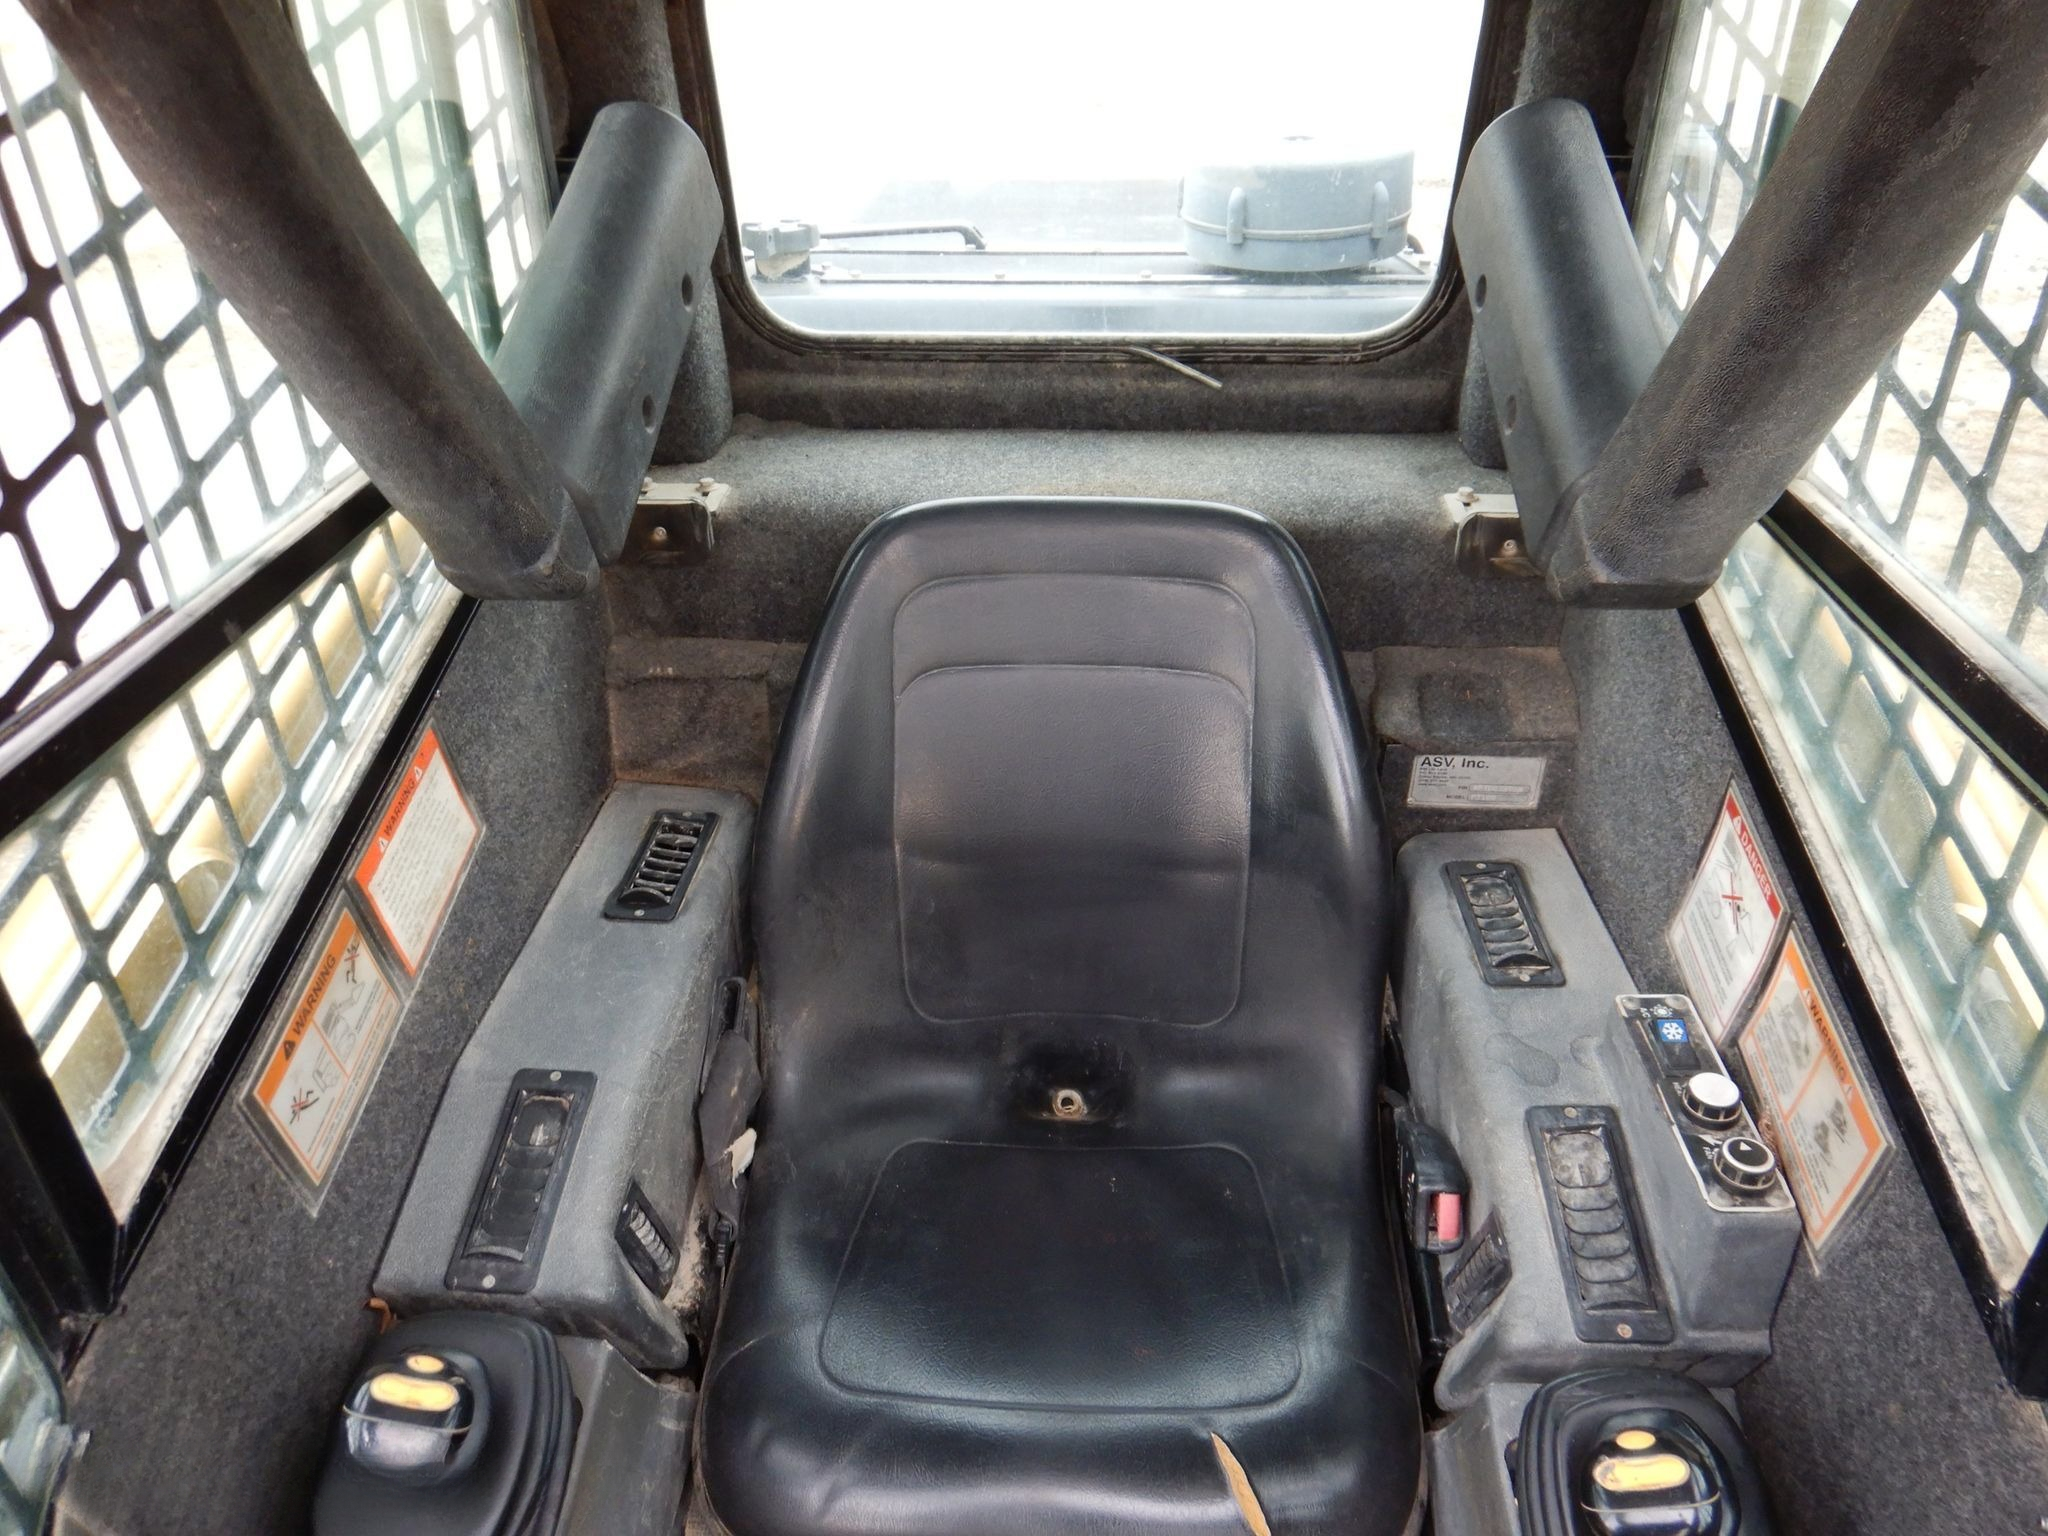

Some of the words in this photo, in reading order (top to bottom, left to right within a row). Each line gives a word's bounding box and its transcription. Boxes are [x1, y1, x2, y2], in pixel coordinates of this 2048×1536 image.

[1461, 758, 1489, 769] Inc.
[384, 778, 416, 836] WARNING
[1740, 829, 1773, 900] DANGER
[293, 954, 337, 1036] WARNING
[1809, 999, 1848, 1084] WARNING
